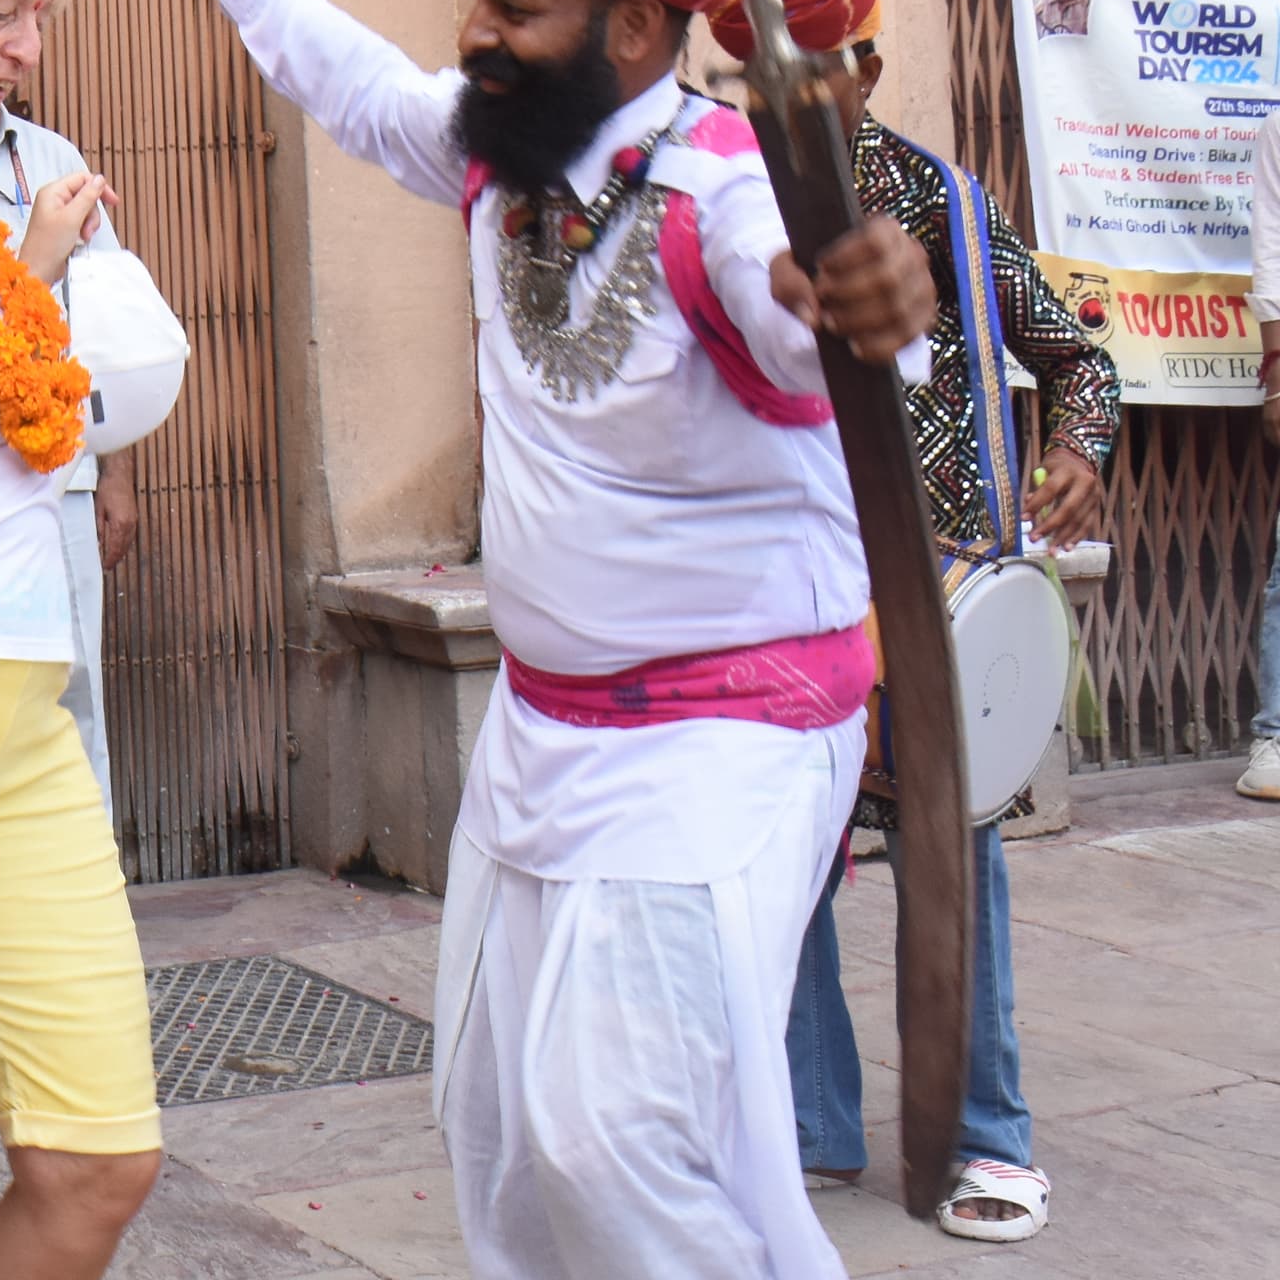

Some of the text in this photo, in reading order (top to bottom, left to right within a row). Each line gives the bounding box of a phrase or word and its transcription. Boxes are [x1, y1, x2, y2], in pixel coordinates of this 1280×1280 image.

[1131, 0, 1257, 29] WORLD
[1133, 29, 1264, 58] TOURISM
[1137, 55, 1261, 85] DAY 2024
[1208, 99, 1235, 114] 27th
[1054, 116, 1259, 142] Traonal Welcome of Touri
[1153, 147, 1196, 162] Drive
[1207, 148, 1237, 163] Bika
[1238, 149, 1253, 163] Ji
[1058, 162, 1079, 177] All
[1120, 167, 1132, 182] &
[1136, 167, 1203, 186] Student
[1204, 170, 1233, 186] Free
[1103, 189, 1210, 212] Performance
[1213, 195, 1235, 217] By
[1202, 221, 1250, 241] Nritya
[1116, 290, 1249, 339] TOURIST
[1164, 357, 1224, 380] RTDC
